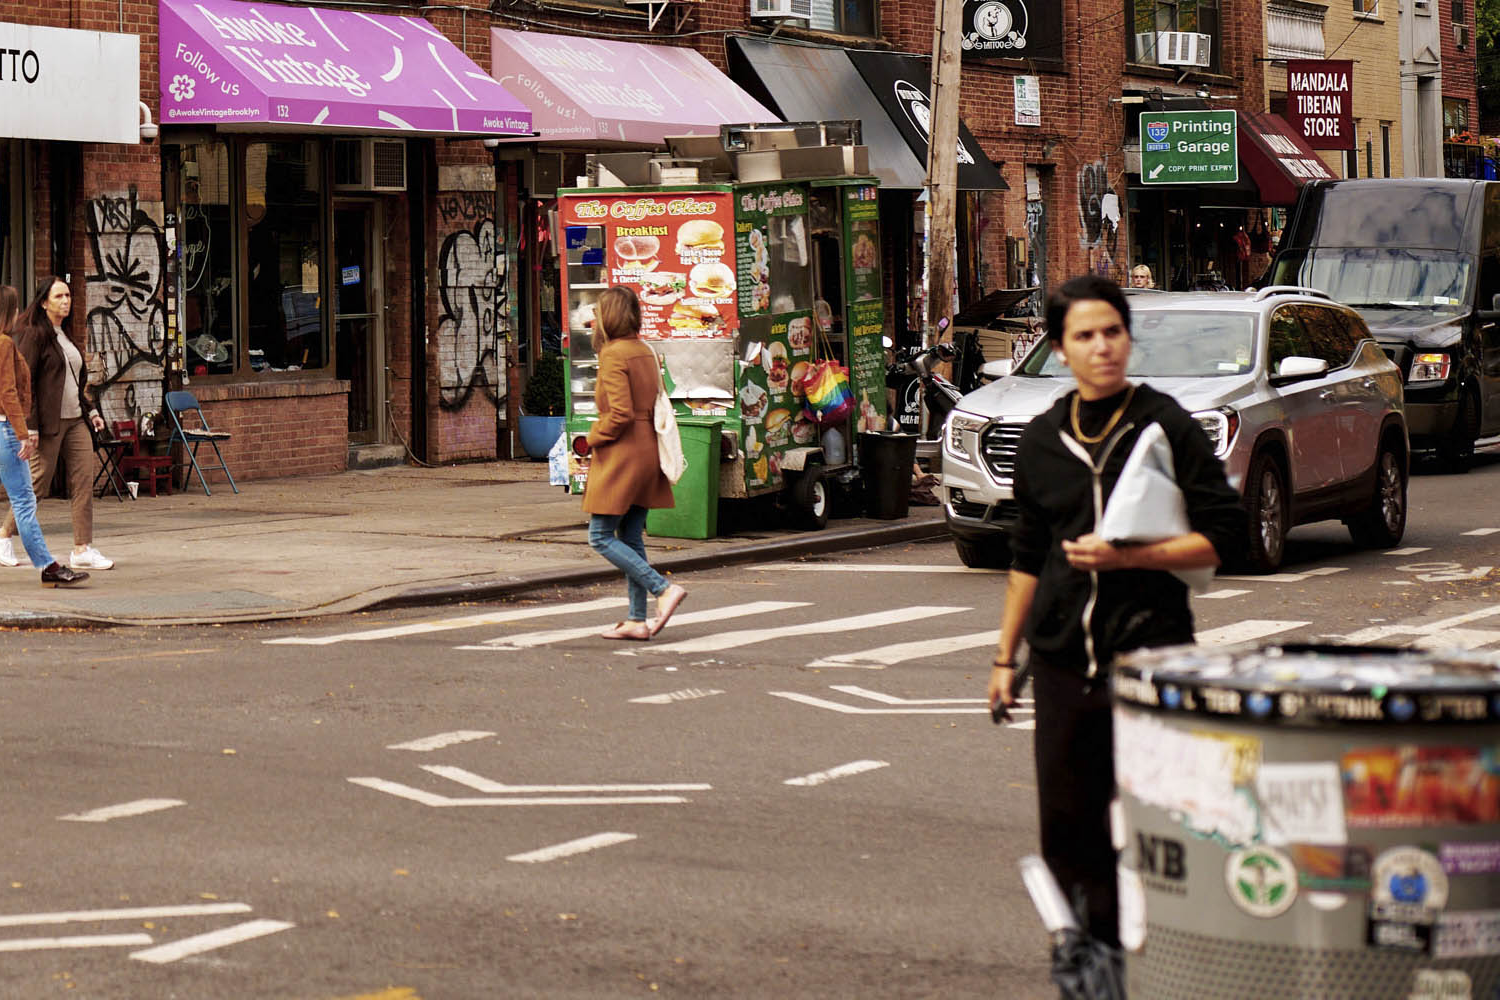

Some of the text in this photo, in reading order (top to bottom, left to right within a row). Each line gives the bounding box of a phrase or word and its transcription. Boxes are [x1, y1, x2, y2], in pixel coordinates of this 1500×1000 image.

[195, 3, 316, 48] Awoke
[176, 42, 240, 96] Follow us
[225, 45, 372, 97] Vintage
[1291, 73, 1348, 91] MANDALA
[518, 74, 576, 120] Follow us!
[1297, 96, 1341, 114] TIBETAN
[169, 108, 260, 118] @AwokeVintageBrooklyn
[277, 105, 529, 132] 132 Awoke Vintage
[1173, 120, 1231, 136] Printing
[1304, 118, 1340, 137] STORE
[1178, 141, 1229, 154] Garage
[575, 198, 716, 220] The Coffee Place
[741, 189, 803, 214] The Coffee Place
[616, 226, 668, 237] Breakfast
